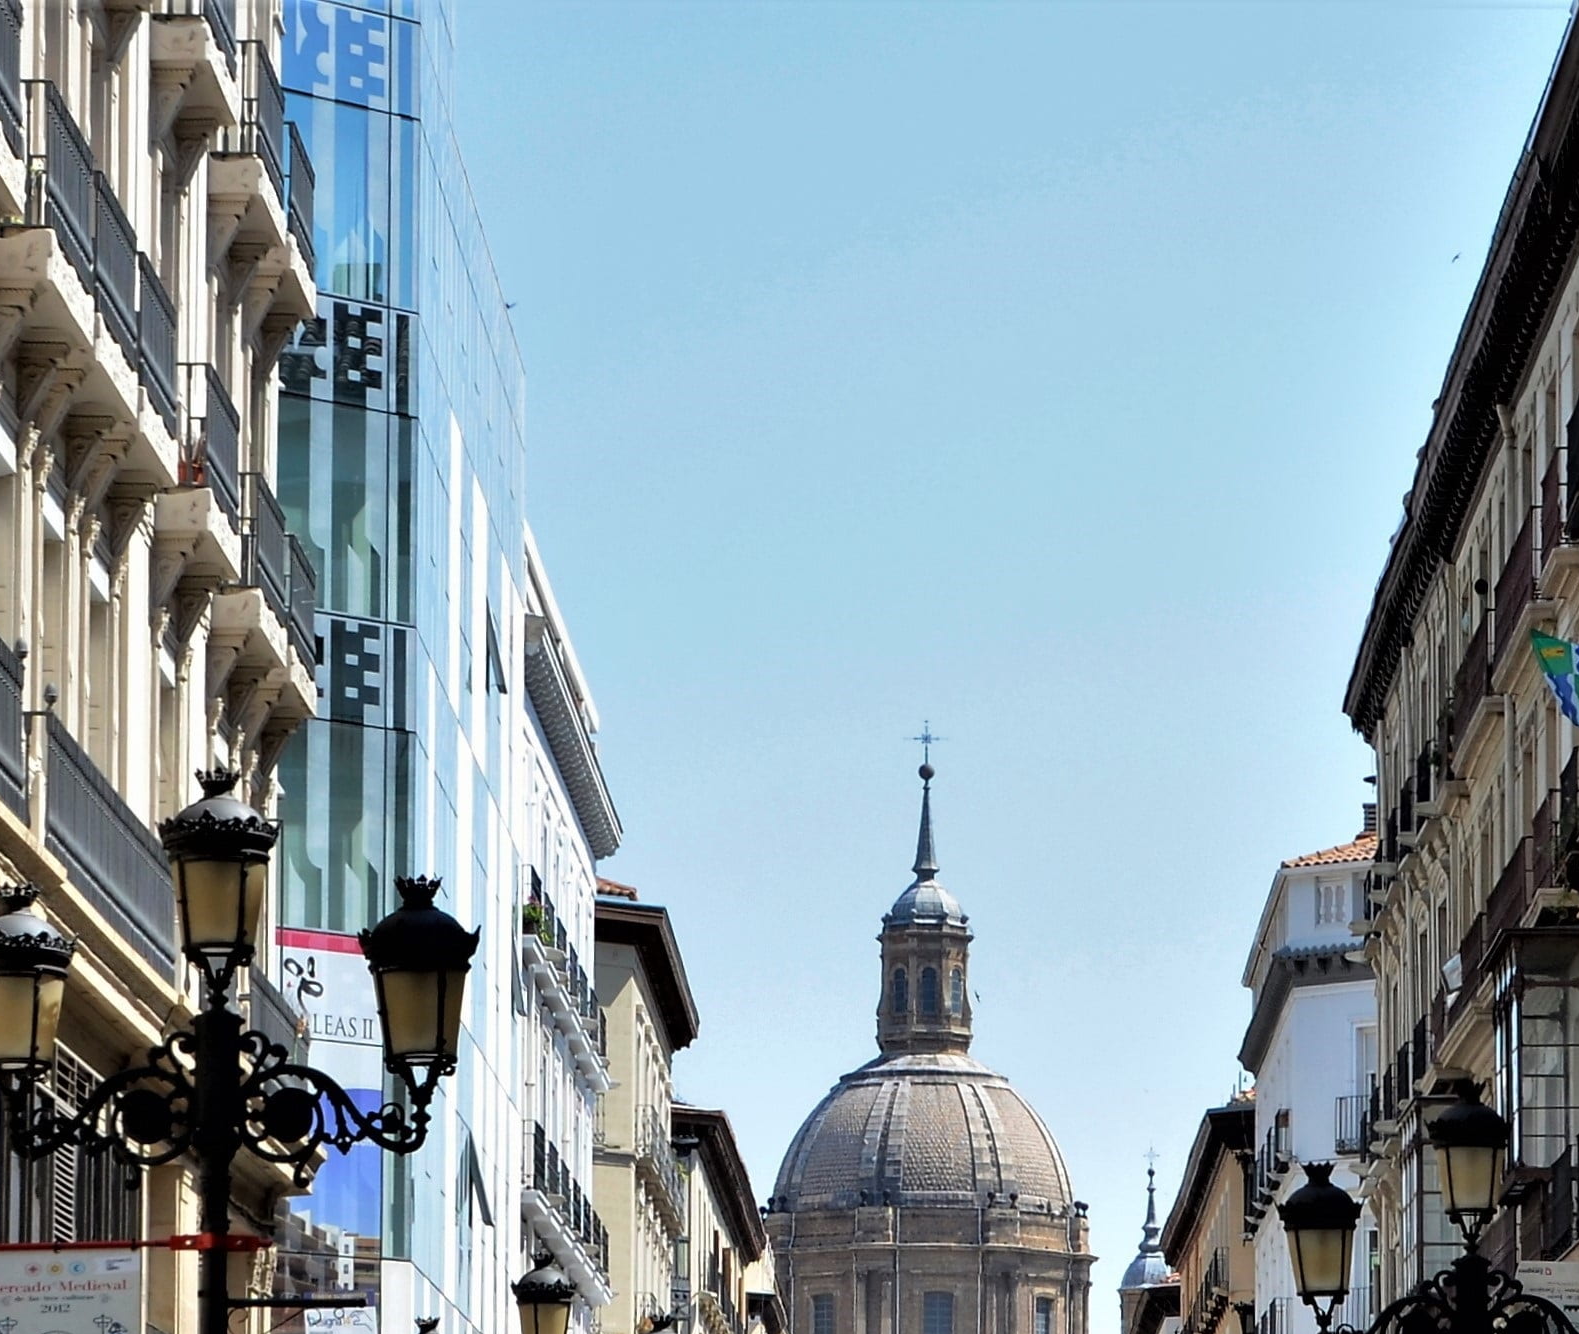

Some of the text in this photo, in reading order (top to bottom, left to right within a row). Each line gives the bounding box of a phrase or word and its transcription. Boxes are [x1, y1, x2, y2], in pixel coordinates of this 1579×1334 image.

[363, 1019, 373, 1040] II
[59, 1280, 128, 1292] Medieval
[40, 1304, 70, 1314] 2012
